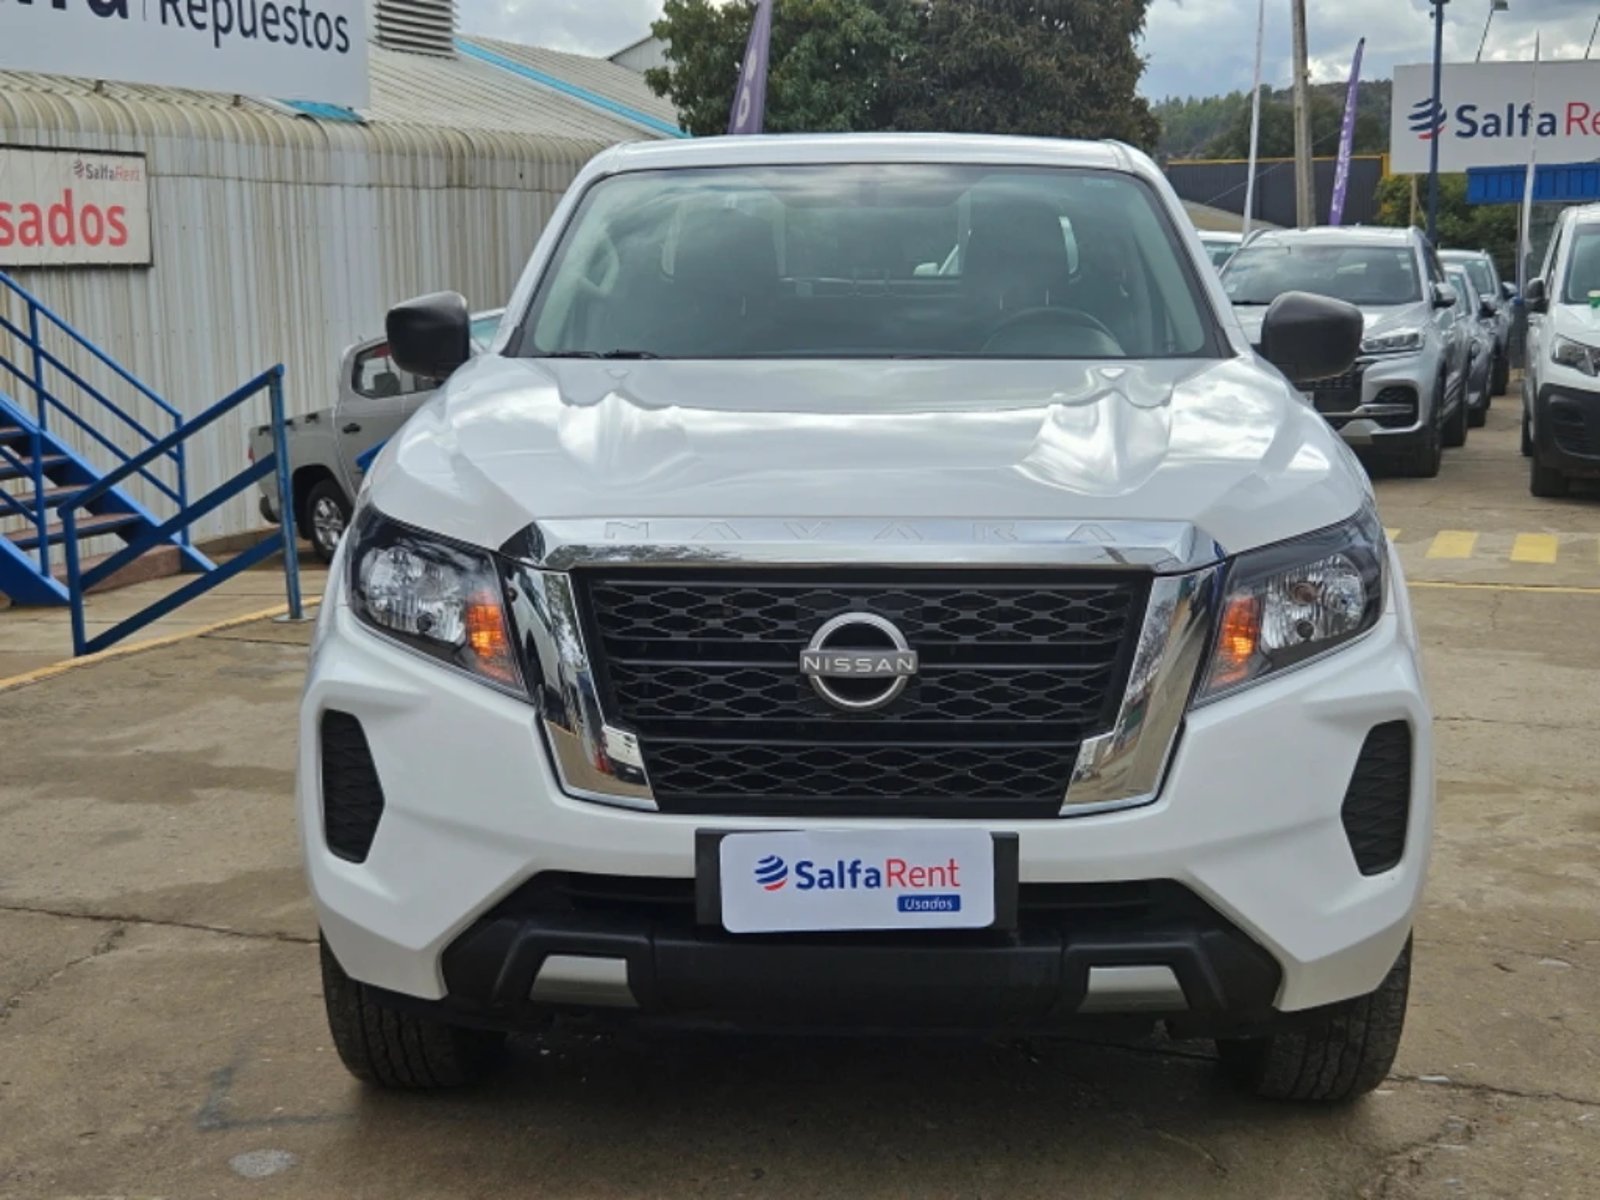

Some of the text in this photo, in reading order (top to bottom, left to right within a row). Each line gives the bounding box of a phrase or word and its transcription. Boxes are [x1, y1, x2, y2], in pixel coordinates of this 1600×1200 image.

[604, 521, 1117, 541] NAVARA
[803, 656, 912, 672] NISSAN
[904, 897, 953, 910] Usados
